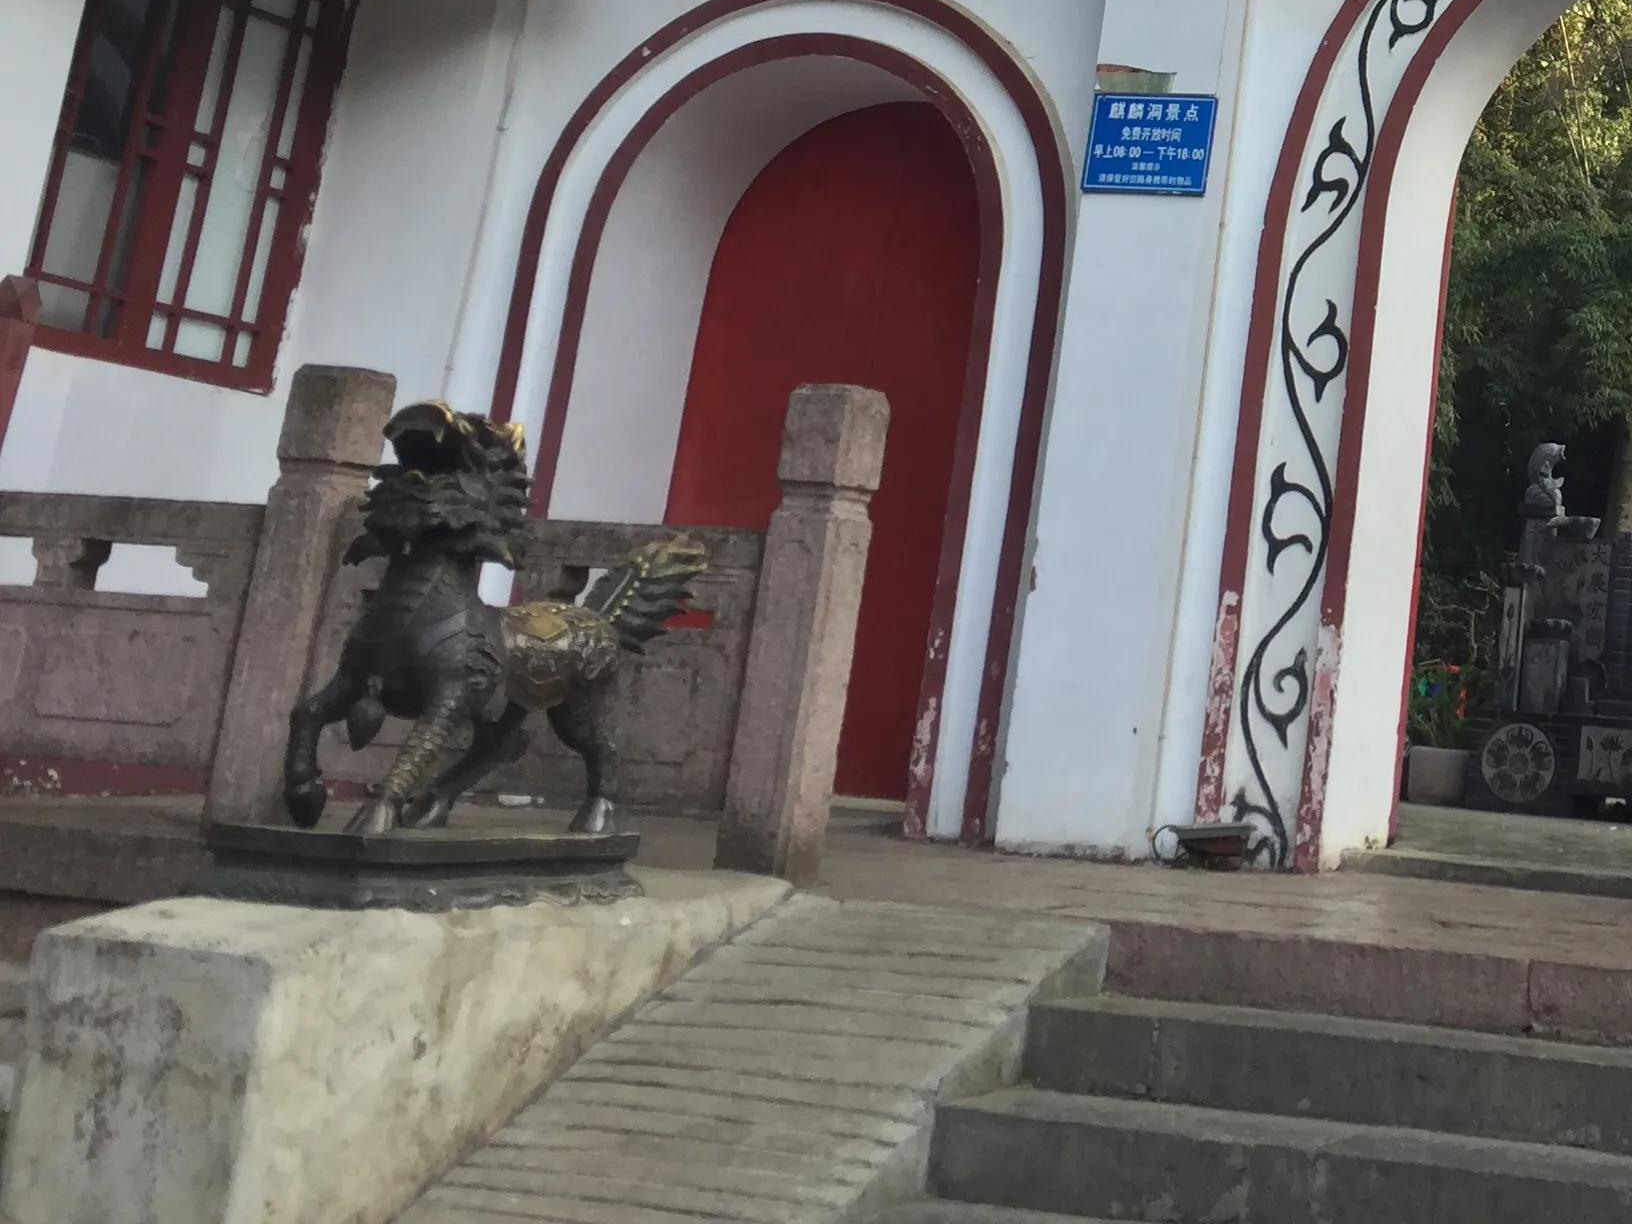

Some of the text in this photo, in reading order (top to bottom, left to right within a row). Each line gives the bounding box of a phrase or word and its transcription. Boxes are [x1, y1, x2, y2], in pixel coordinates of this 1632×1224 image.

[1108, 101, 1200, 122] 麒麟洞景点
[1121, 126, 1182, 143] 免费开放时间
